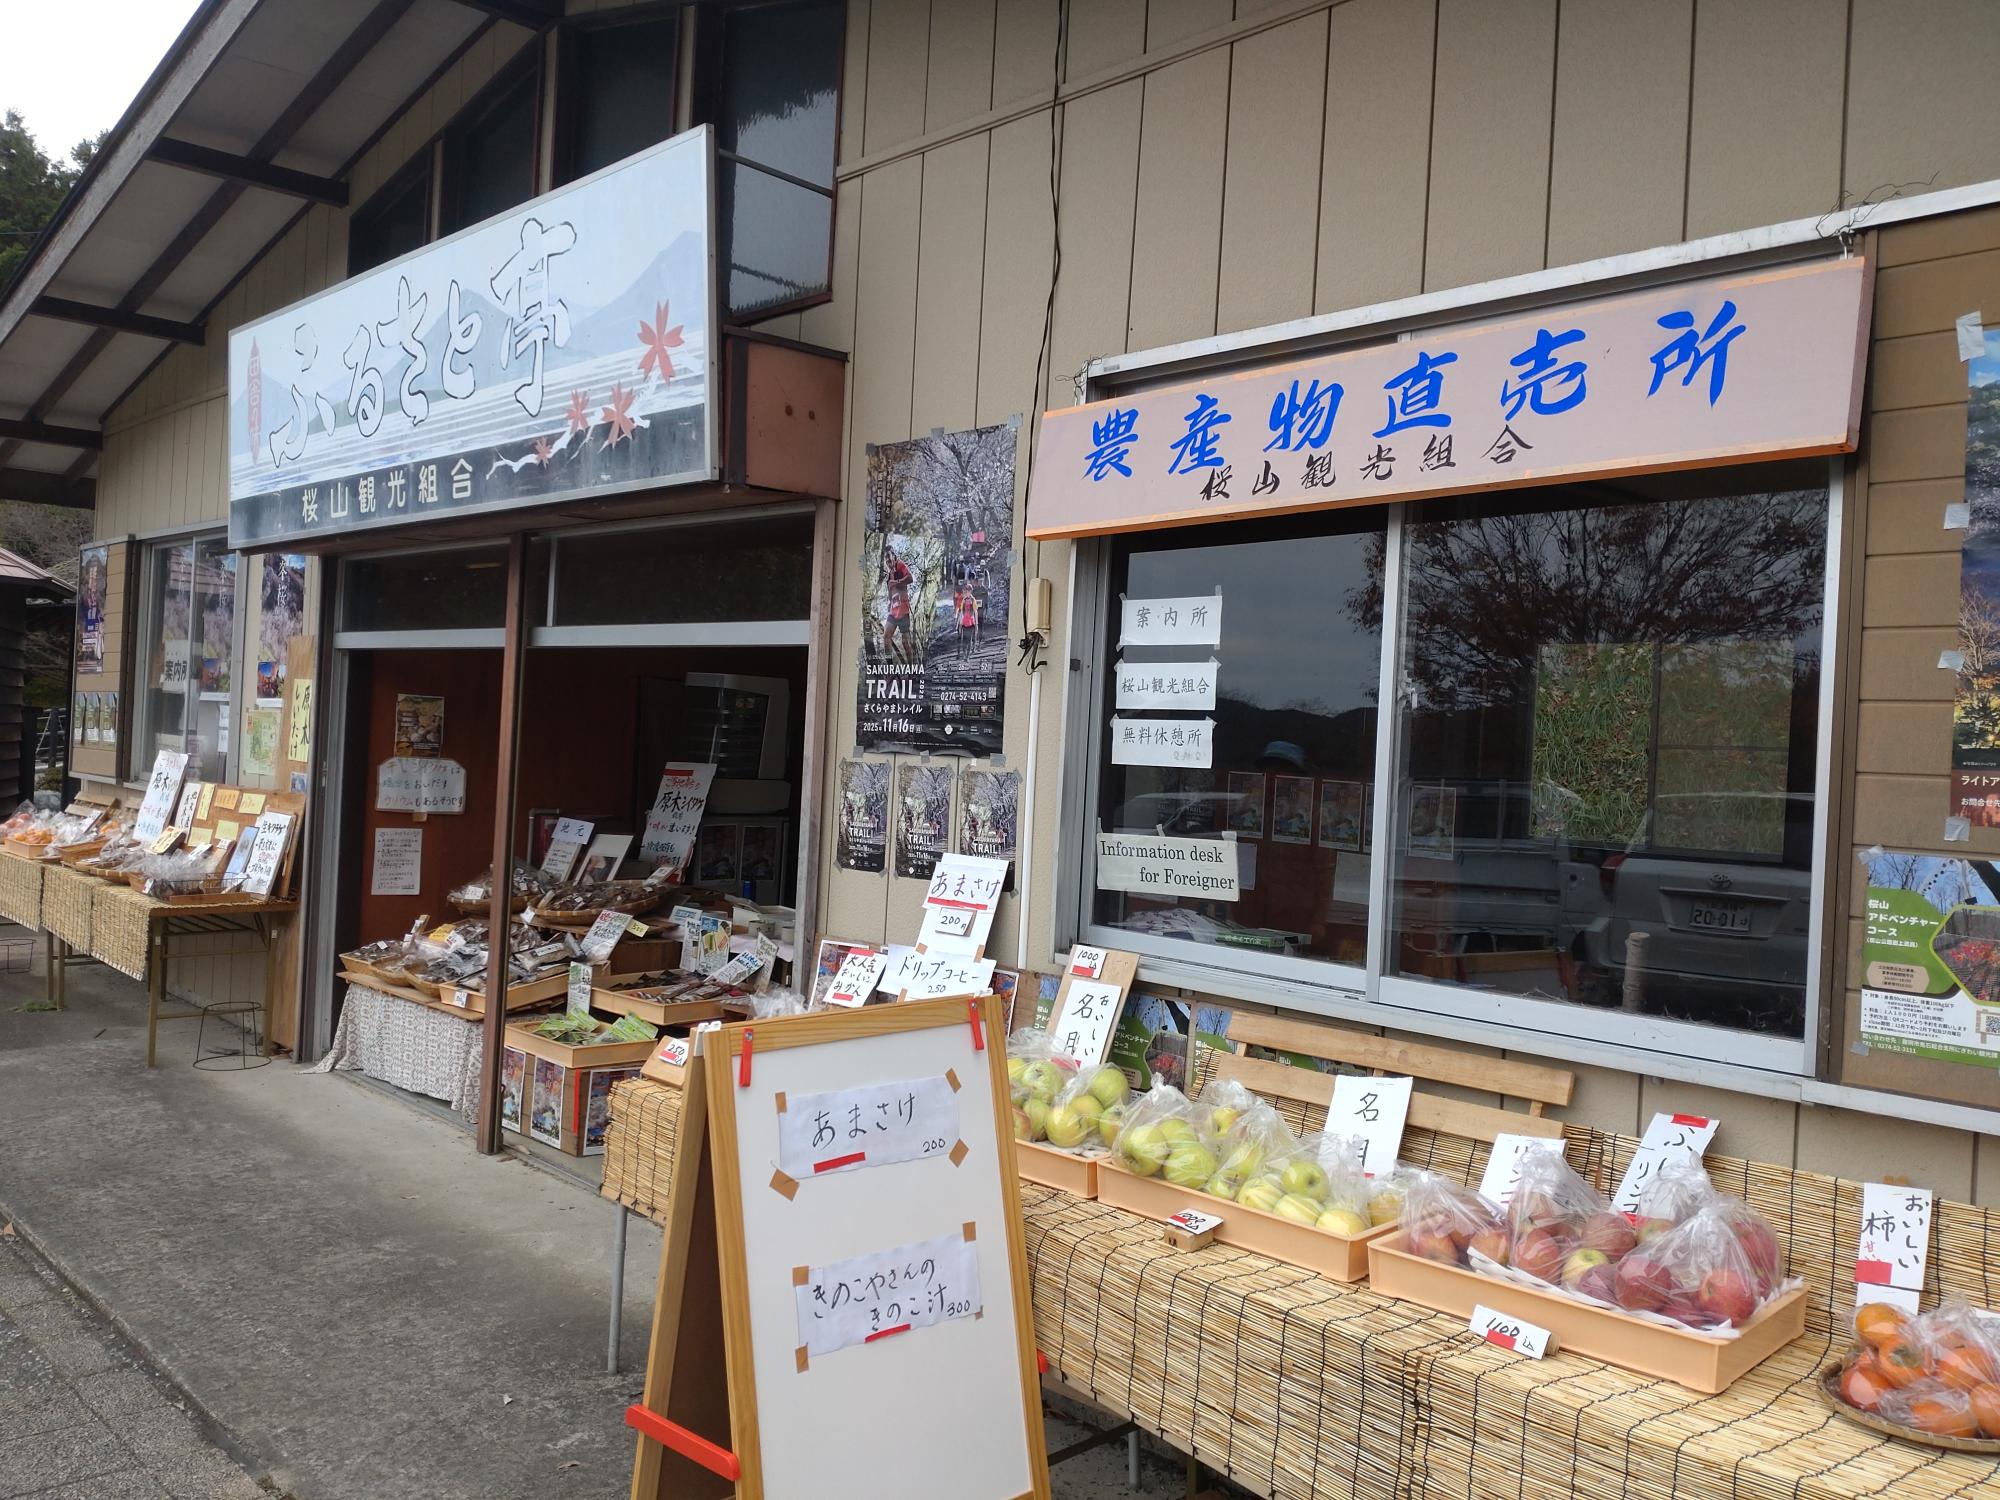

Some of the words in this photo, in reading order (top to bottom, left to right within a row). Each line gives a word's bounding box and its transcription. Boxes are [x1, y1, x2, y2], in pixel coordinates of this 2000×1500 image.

[269, 217, 577, 469] ふるさと亭
[1083, 299, 1749, 481] 農産物直売所
[1199, 426, 1536, 502] 桜山観光組合
[301, 458, 474, 523] 桜山観光組合
[1135, 606, 1208, 628] 案内所
[866, 663, 925, 675] SAKURAYAMA
[866, 679, 917, 699] TRAIL
[1121, 677, 1210, 695] 桜山観光組合
[940, 691, 987, 702] 0274-52-4143
[863, 703, 923, 715] さくらやまトレイル
[1121, 726, 1202, 749] 無料休憩所
[909, 834, 932, 846] TRAIL
[973, 843, 998, 854] TRAIL
[1100, 839, 1185, 861] Information
[1190, 846, 1224, 864] desk
[931, 871, 1000, 899] あまさけ
[1139, 866, 1160, 884] for
[1163, 868, 1235, 891] Foreigner
[1868, 899, 1889, 910] 桜山
[1868, 912, 1940, 927] アドベンチャー
[1867, 926, 1897, 937] コース
[847, 955, 877, 974] 大人気
[1077, 949, 1099, 962] 1000
[898, 956, 980, 982] ドリップコーヒー
[833, 980, 862, 997] みかん
[927, 984, 946, 994] 250
[668, 1044, 685, 1056] 250
[812, 1093, 916, 1150] あまさけ
[922, 1137, 946, 1153] 200
[1861, 1210, 1897, 1243] 柿
[1897, 1194, 1930, 1269] おいしい
[812, 1258, 936, 1320] きのこやさんの
[870, 1283, 948, 1332] きのこ汁
[946, 1299, 971, 1318] 300
